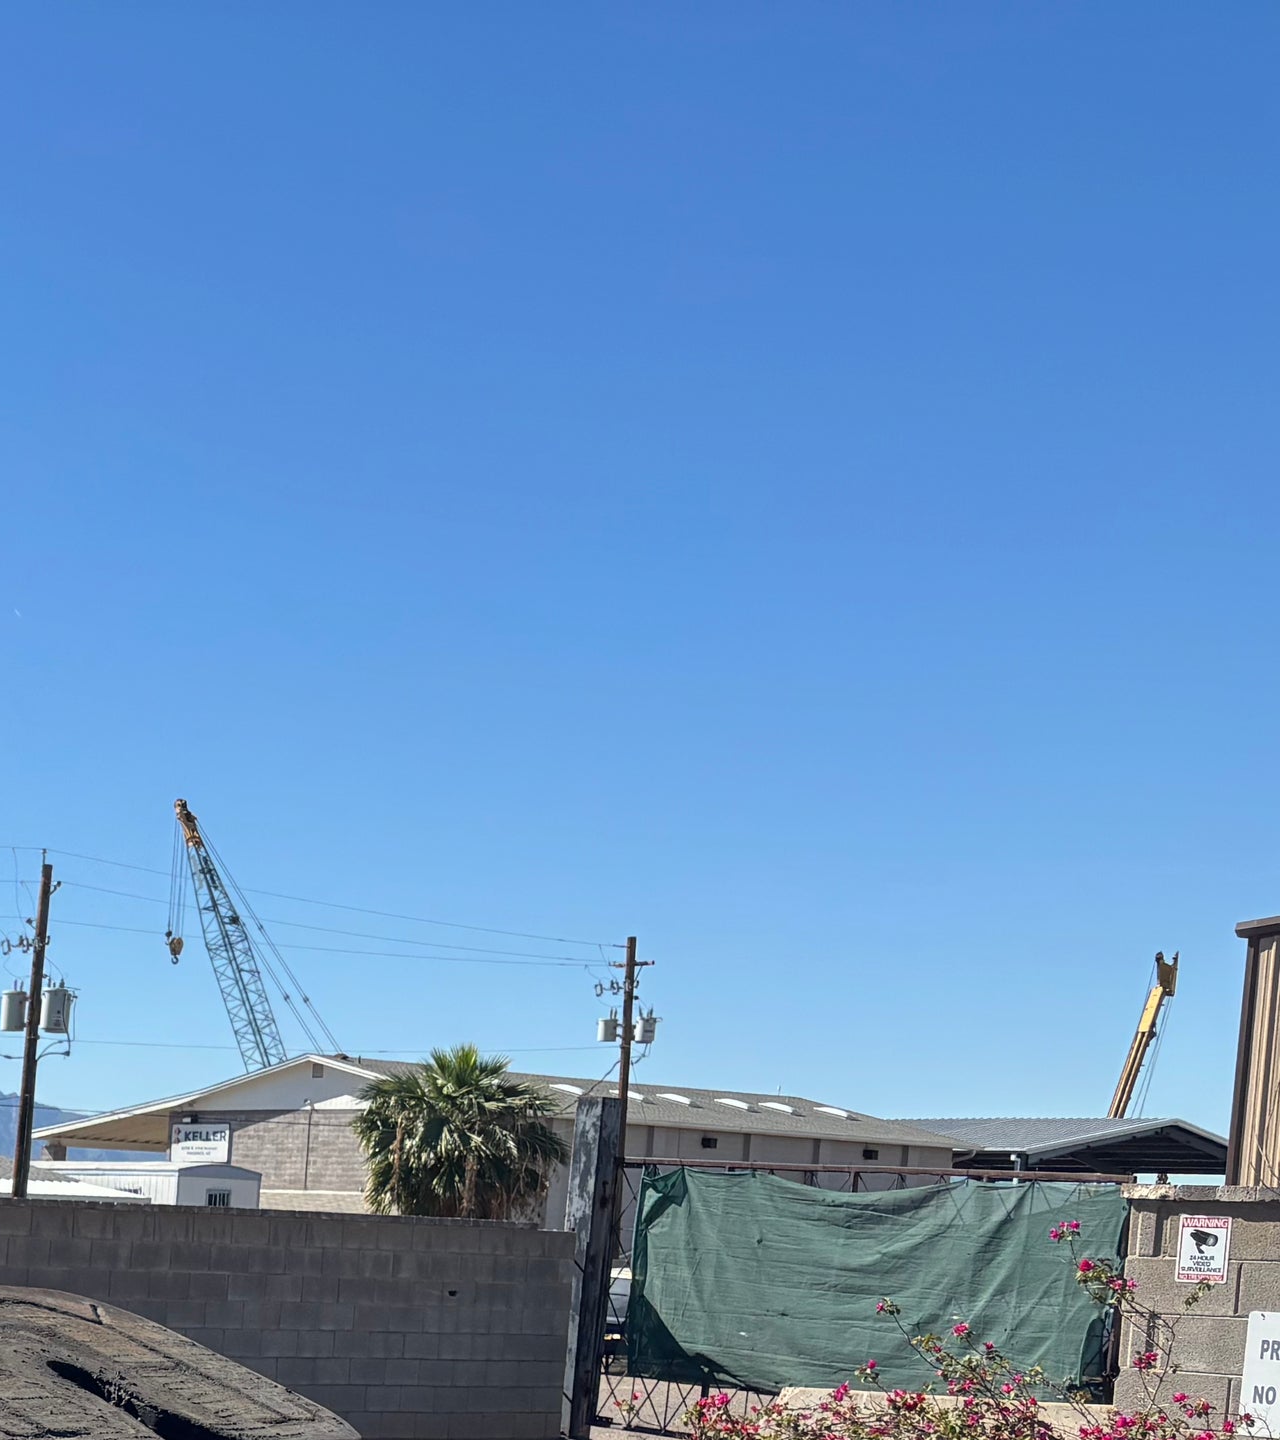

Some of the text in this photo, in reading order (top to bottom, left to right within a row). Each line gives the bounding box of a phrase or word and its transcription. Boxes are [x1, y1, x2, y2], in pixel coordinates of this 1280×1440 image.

[184, 1130, 227, 1142] KELLER
[1183, 1218, 1228, 1228] WARNING
[1252, 1385, 1277, 1406] NO
